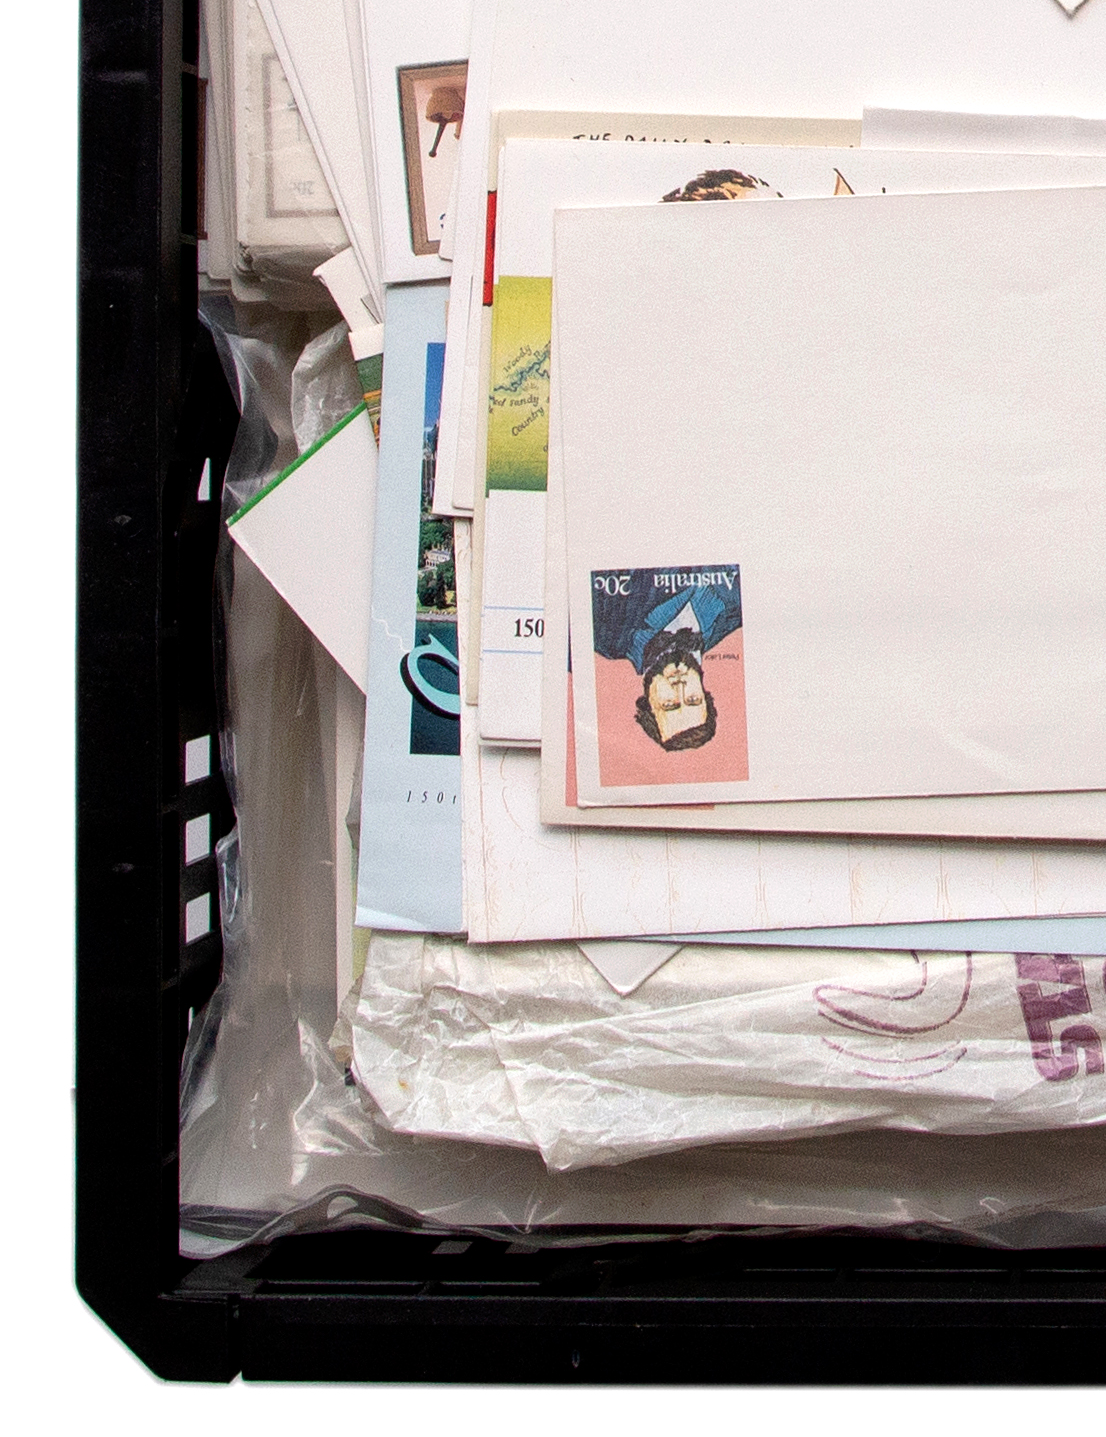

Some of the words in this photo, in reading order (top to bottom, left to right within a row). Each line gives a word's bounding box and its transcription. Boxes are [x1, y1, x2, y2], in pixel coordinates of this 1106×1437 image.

[511, 406, 545, 436] Country
[594, 574, 632, 597] 20c
[654, 570, 738, 594] Australia
[514, 618, 545, 638] 150
